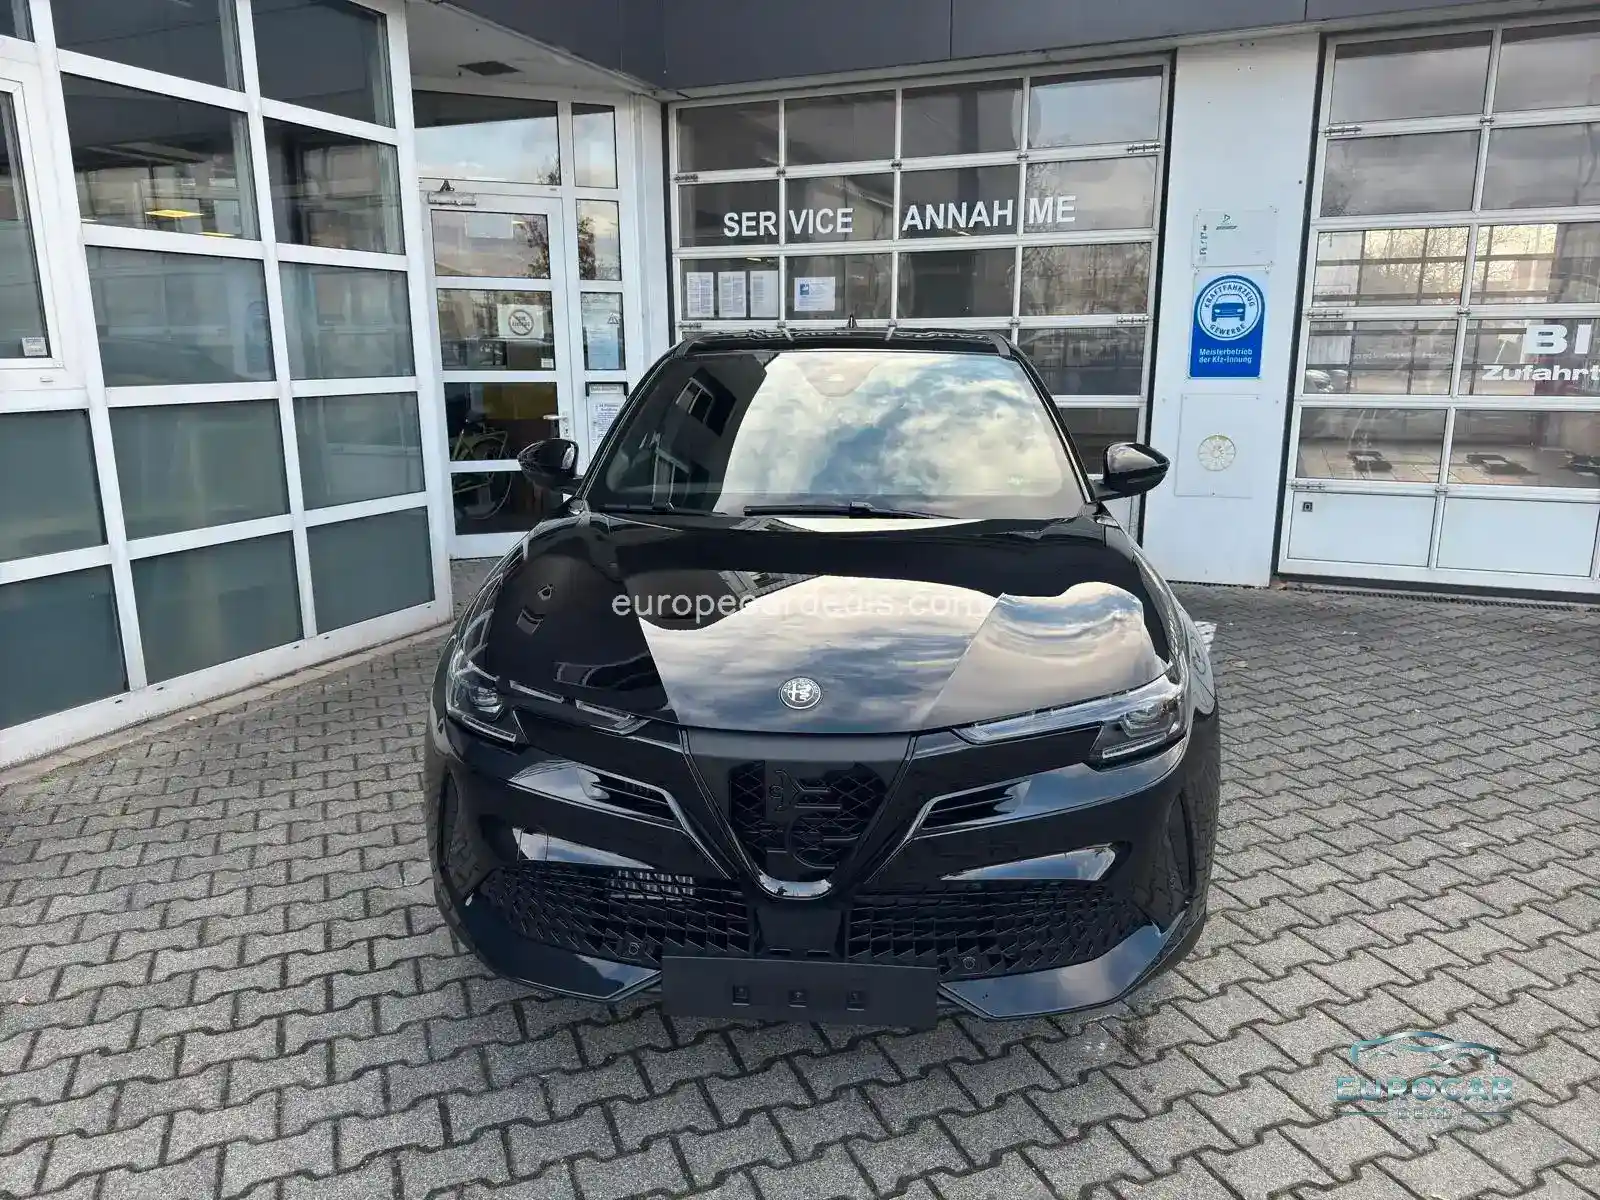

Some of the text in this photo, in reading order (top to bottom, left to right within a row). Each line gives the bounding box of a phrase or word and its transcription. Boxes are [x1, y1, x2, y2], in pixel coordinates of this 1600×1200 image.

[723, 195, 1076, 237] SERVICE ANNAHME
[1203, 284, 1256, 308] KRAFTFAHRZEUG
[1209, 322, 1246, 335] GEWERBE
[1199, 348, 1253, 356] Meisterbetrieb
[1198, 355, 1253, 364] der Kfz-Innung
